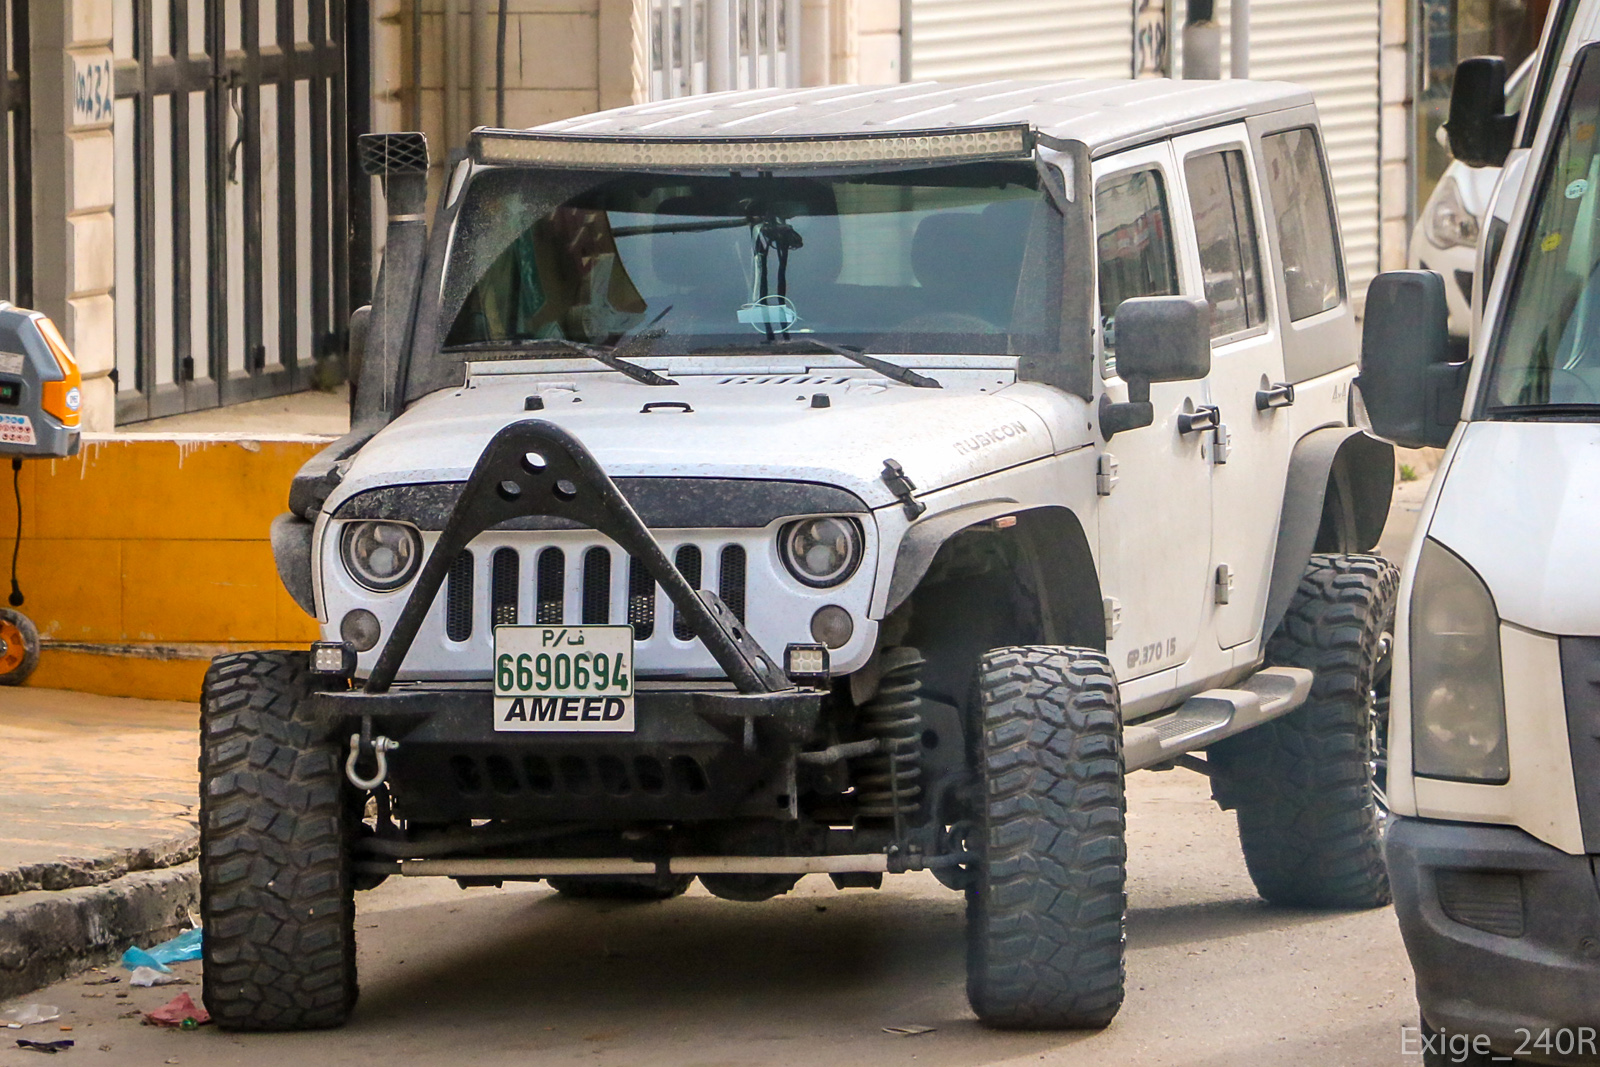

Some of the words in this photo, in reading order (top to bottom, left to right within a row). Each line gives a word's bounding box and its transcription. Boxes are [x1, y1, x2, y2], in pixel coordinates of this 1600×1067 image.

[952, 420, 1028, 456] RUBICON
[497, 652, 629, 692] 6690694
[503, 697, 626, 722] AMEED
